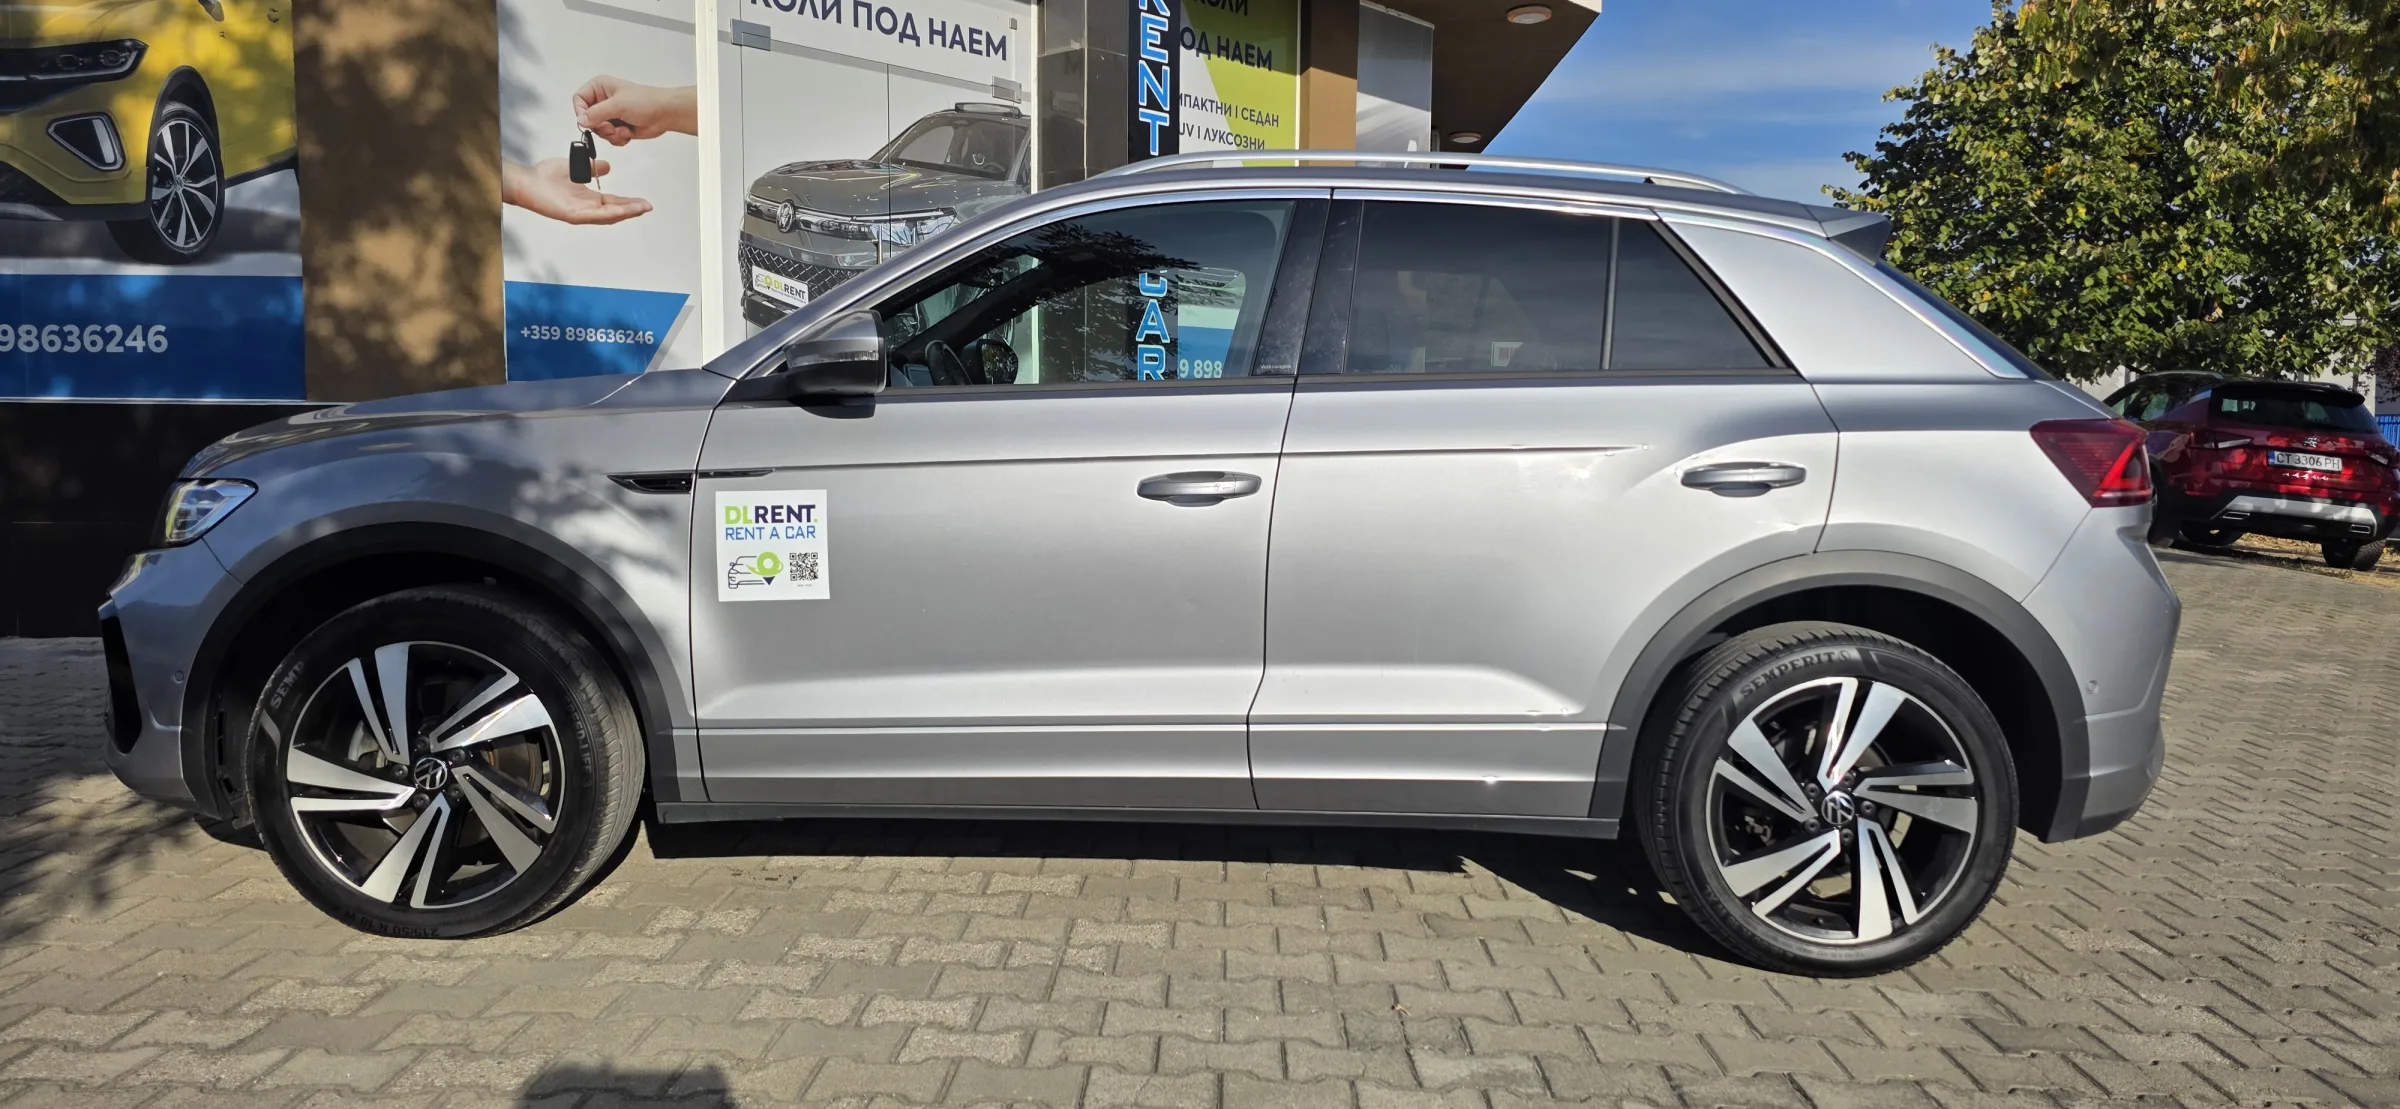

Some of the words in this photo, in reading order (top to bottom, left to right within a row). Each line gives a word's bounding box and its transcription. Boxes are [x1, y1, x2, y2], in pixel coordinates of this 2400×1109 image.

[852, 0, 921, 47] ПОД
[928, 17, 1007, 62] НАЕМ
[1216, 35, 1273, 71] НАЕМ
[1240, 106, 1279, 127] СЕДАН
[1203, 127, 1265, 150] ЛУКСОЗНИ
[0, 323, 169, 353] 98636246
[520, 325, 561, 341] +359
[565, 327, 654, 345] 898636246
[2294, 454, 2323, 467] 3306
[725, 526, 765, 541] RENT
[769, 526, 780, 540] A
[785, 525, 816, 540] CAR
[1739, 651, 1836, 697] SEMPERIT
